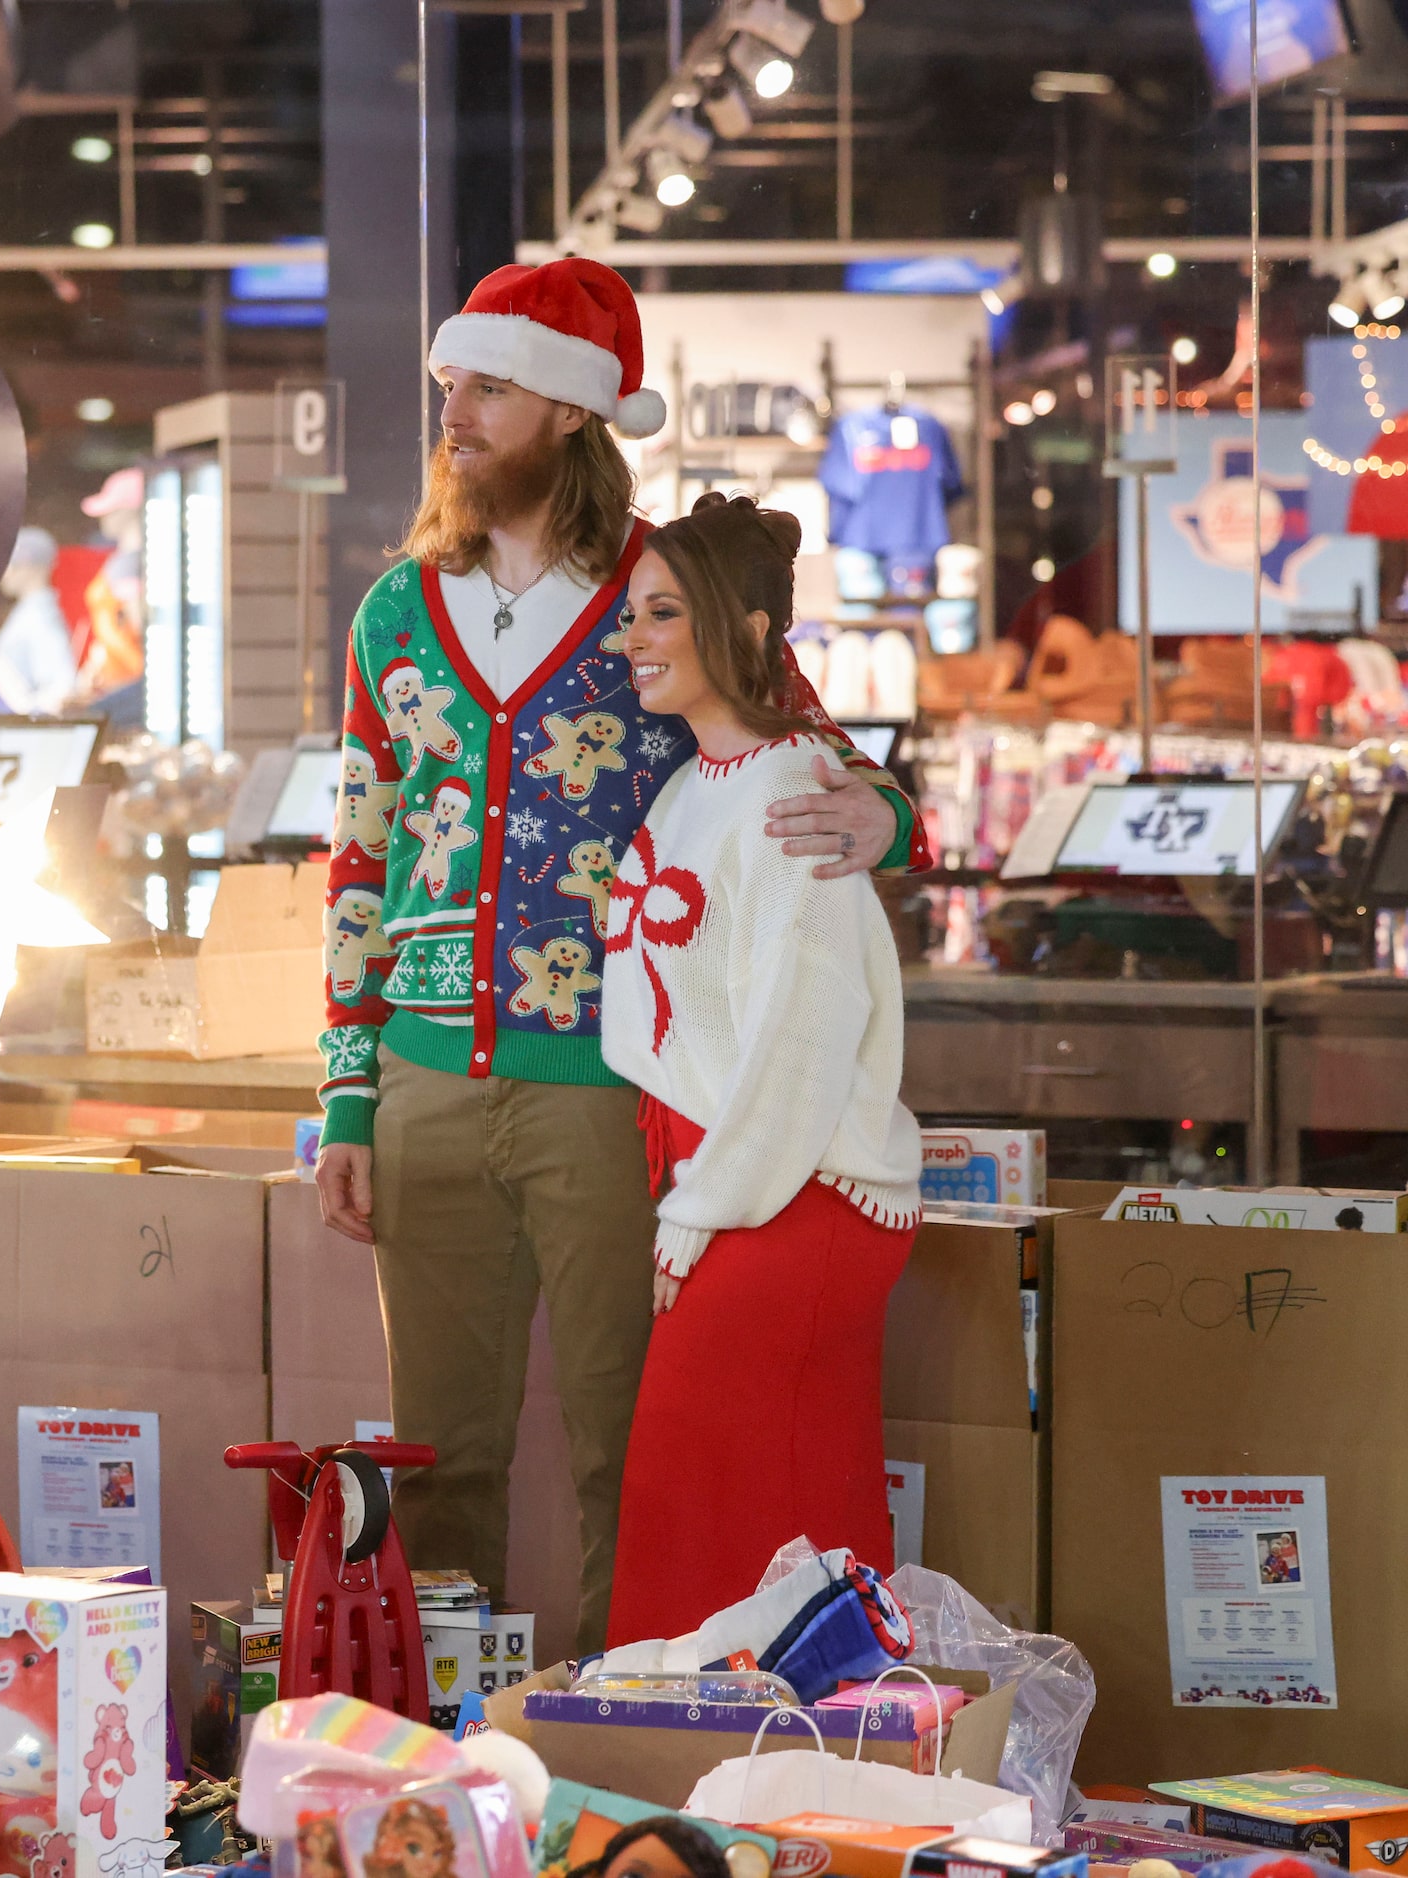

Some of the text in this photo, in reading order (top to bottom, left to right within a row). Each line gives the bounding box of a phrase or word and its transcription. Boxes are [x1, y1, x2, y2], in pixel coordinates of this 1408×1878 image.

[1125, 1205, 1176, 1222] METAL
[37, 1420, 141, 1437] TOY DRIVE
[1181, 1489, 1305, 1505] TOY DRIVE
[86, 1600, 160, 1622] HELLO KITTY
[87, 1616, 160, 1637] AND FRIENDS
[246, 1636, 271, 1650] NEW
[436, 1660, 455, 1669] RTR
